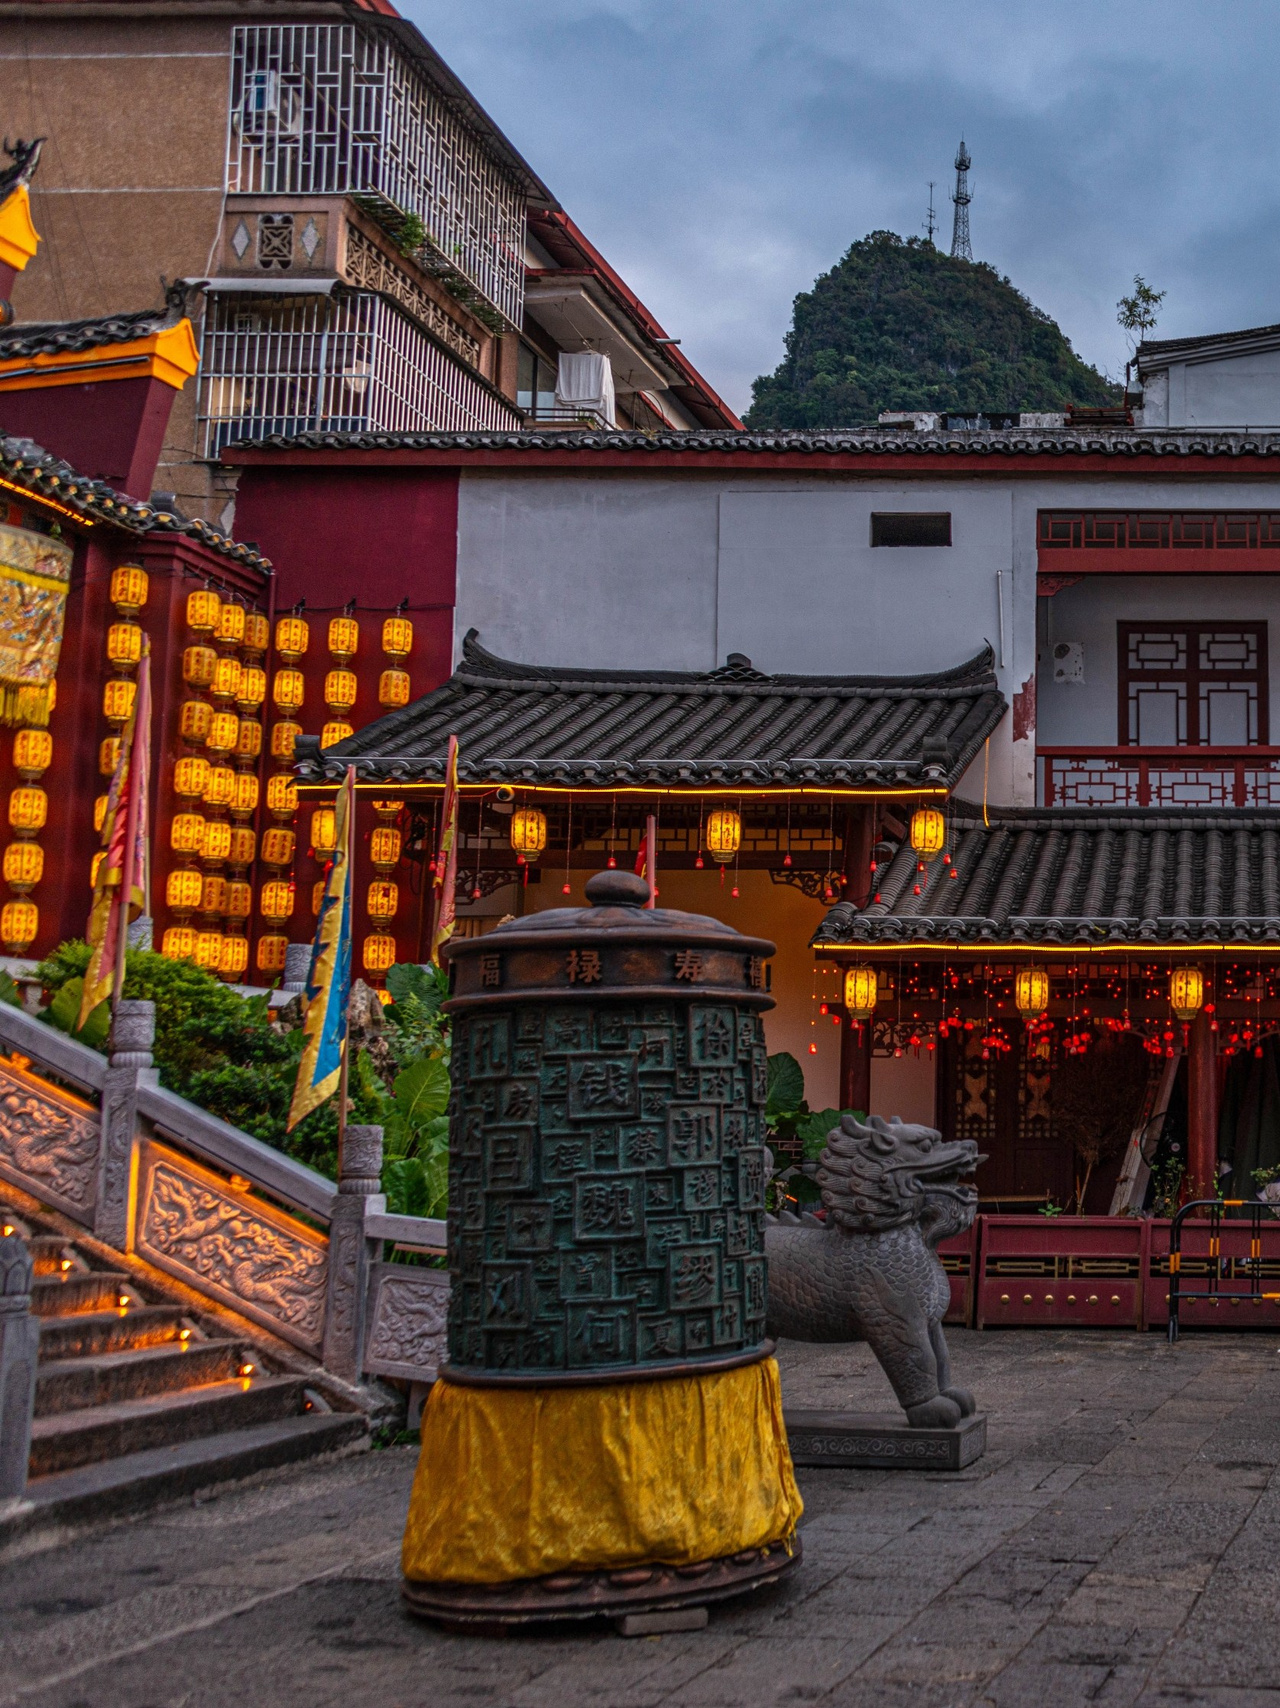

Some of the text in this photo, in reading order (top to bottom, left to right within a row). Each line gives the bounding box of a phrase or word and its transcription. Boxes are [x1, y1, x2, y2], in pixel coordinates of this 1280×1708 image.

[479, 953, 500, 986] 福
[565, 949, 602, 984] 禄
[674, 949, 702, 982] 寿
[473, 1022, 506, 1075] 孔
[554, 1016, 584, 1049] 高
[637, 1031, 669, 1066] 柯
[695, 1014, 730, 1060] 徐
[504, 1082, 533, 1119] 房
[577, 1061, 630, 1107] 钱
[626, 1127, 662, 1162] 蔡
[672, 1110, 714, 1158] 郭
[489, 1134, 522, 1182] 吕
[546, 1141, 588, 1173] 程
[582, 1180, 636, 1231] 魏
[688, 1171, 718, 1204] 穆
[569, 1252, 602, 1293] 曾
[674, 1254, 715, 1301] 缪
[485, 1271, 525, 1323] 刘
[573, 1309, 630, 1360] 何
[645, 1318, 679, 1355] 夏
